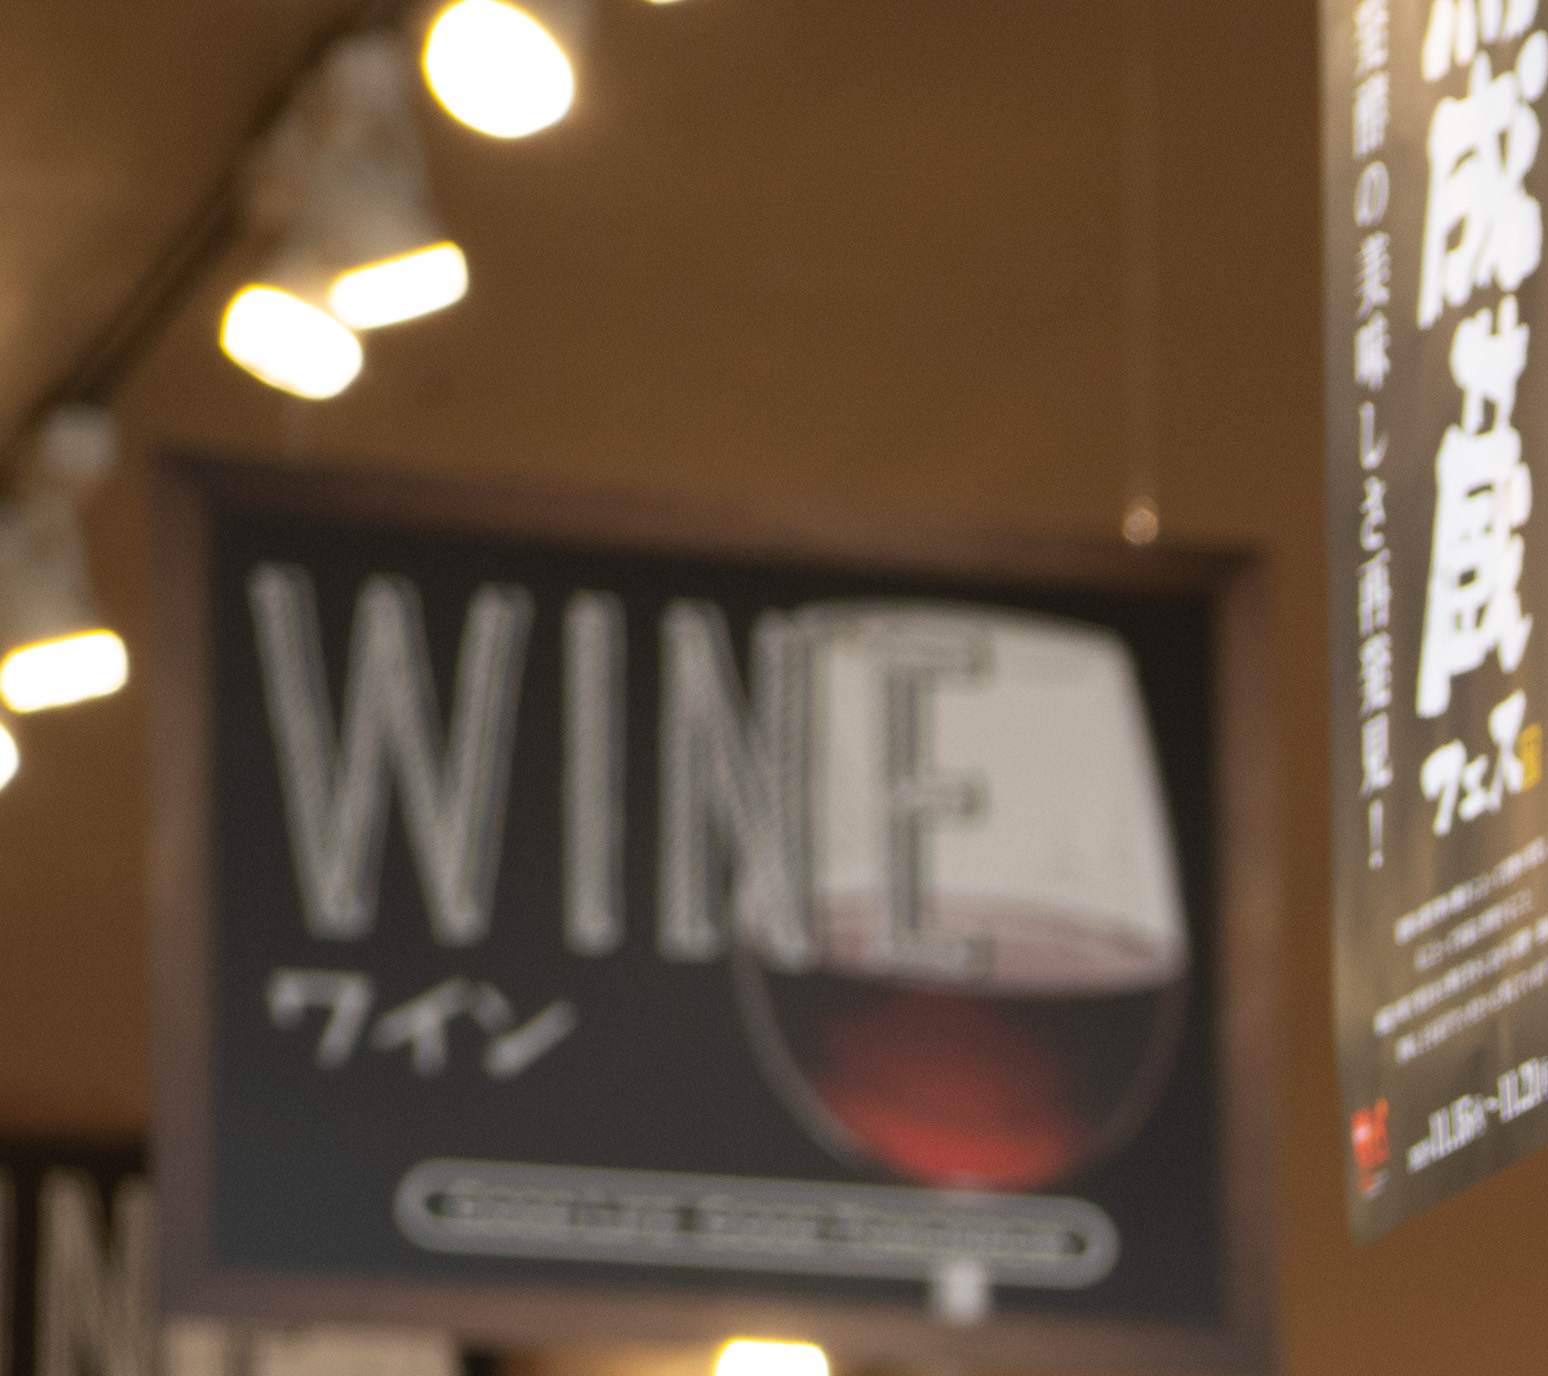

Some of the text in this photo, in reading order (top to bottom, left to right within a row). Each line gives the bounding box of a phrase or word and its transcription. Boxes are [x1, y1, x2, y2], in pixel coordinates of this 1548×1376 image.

[248, 562, 1000, 975] WINE
[1420, 690, 1528, 836] フェス
[266, 966, 578, 1078] ワイン
